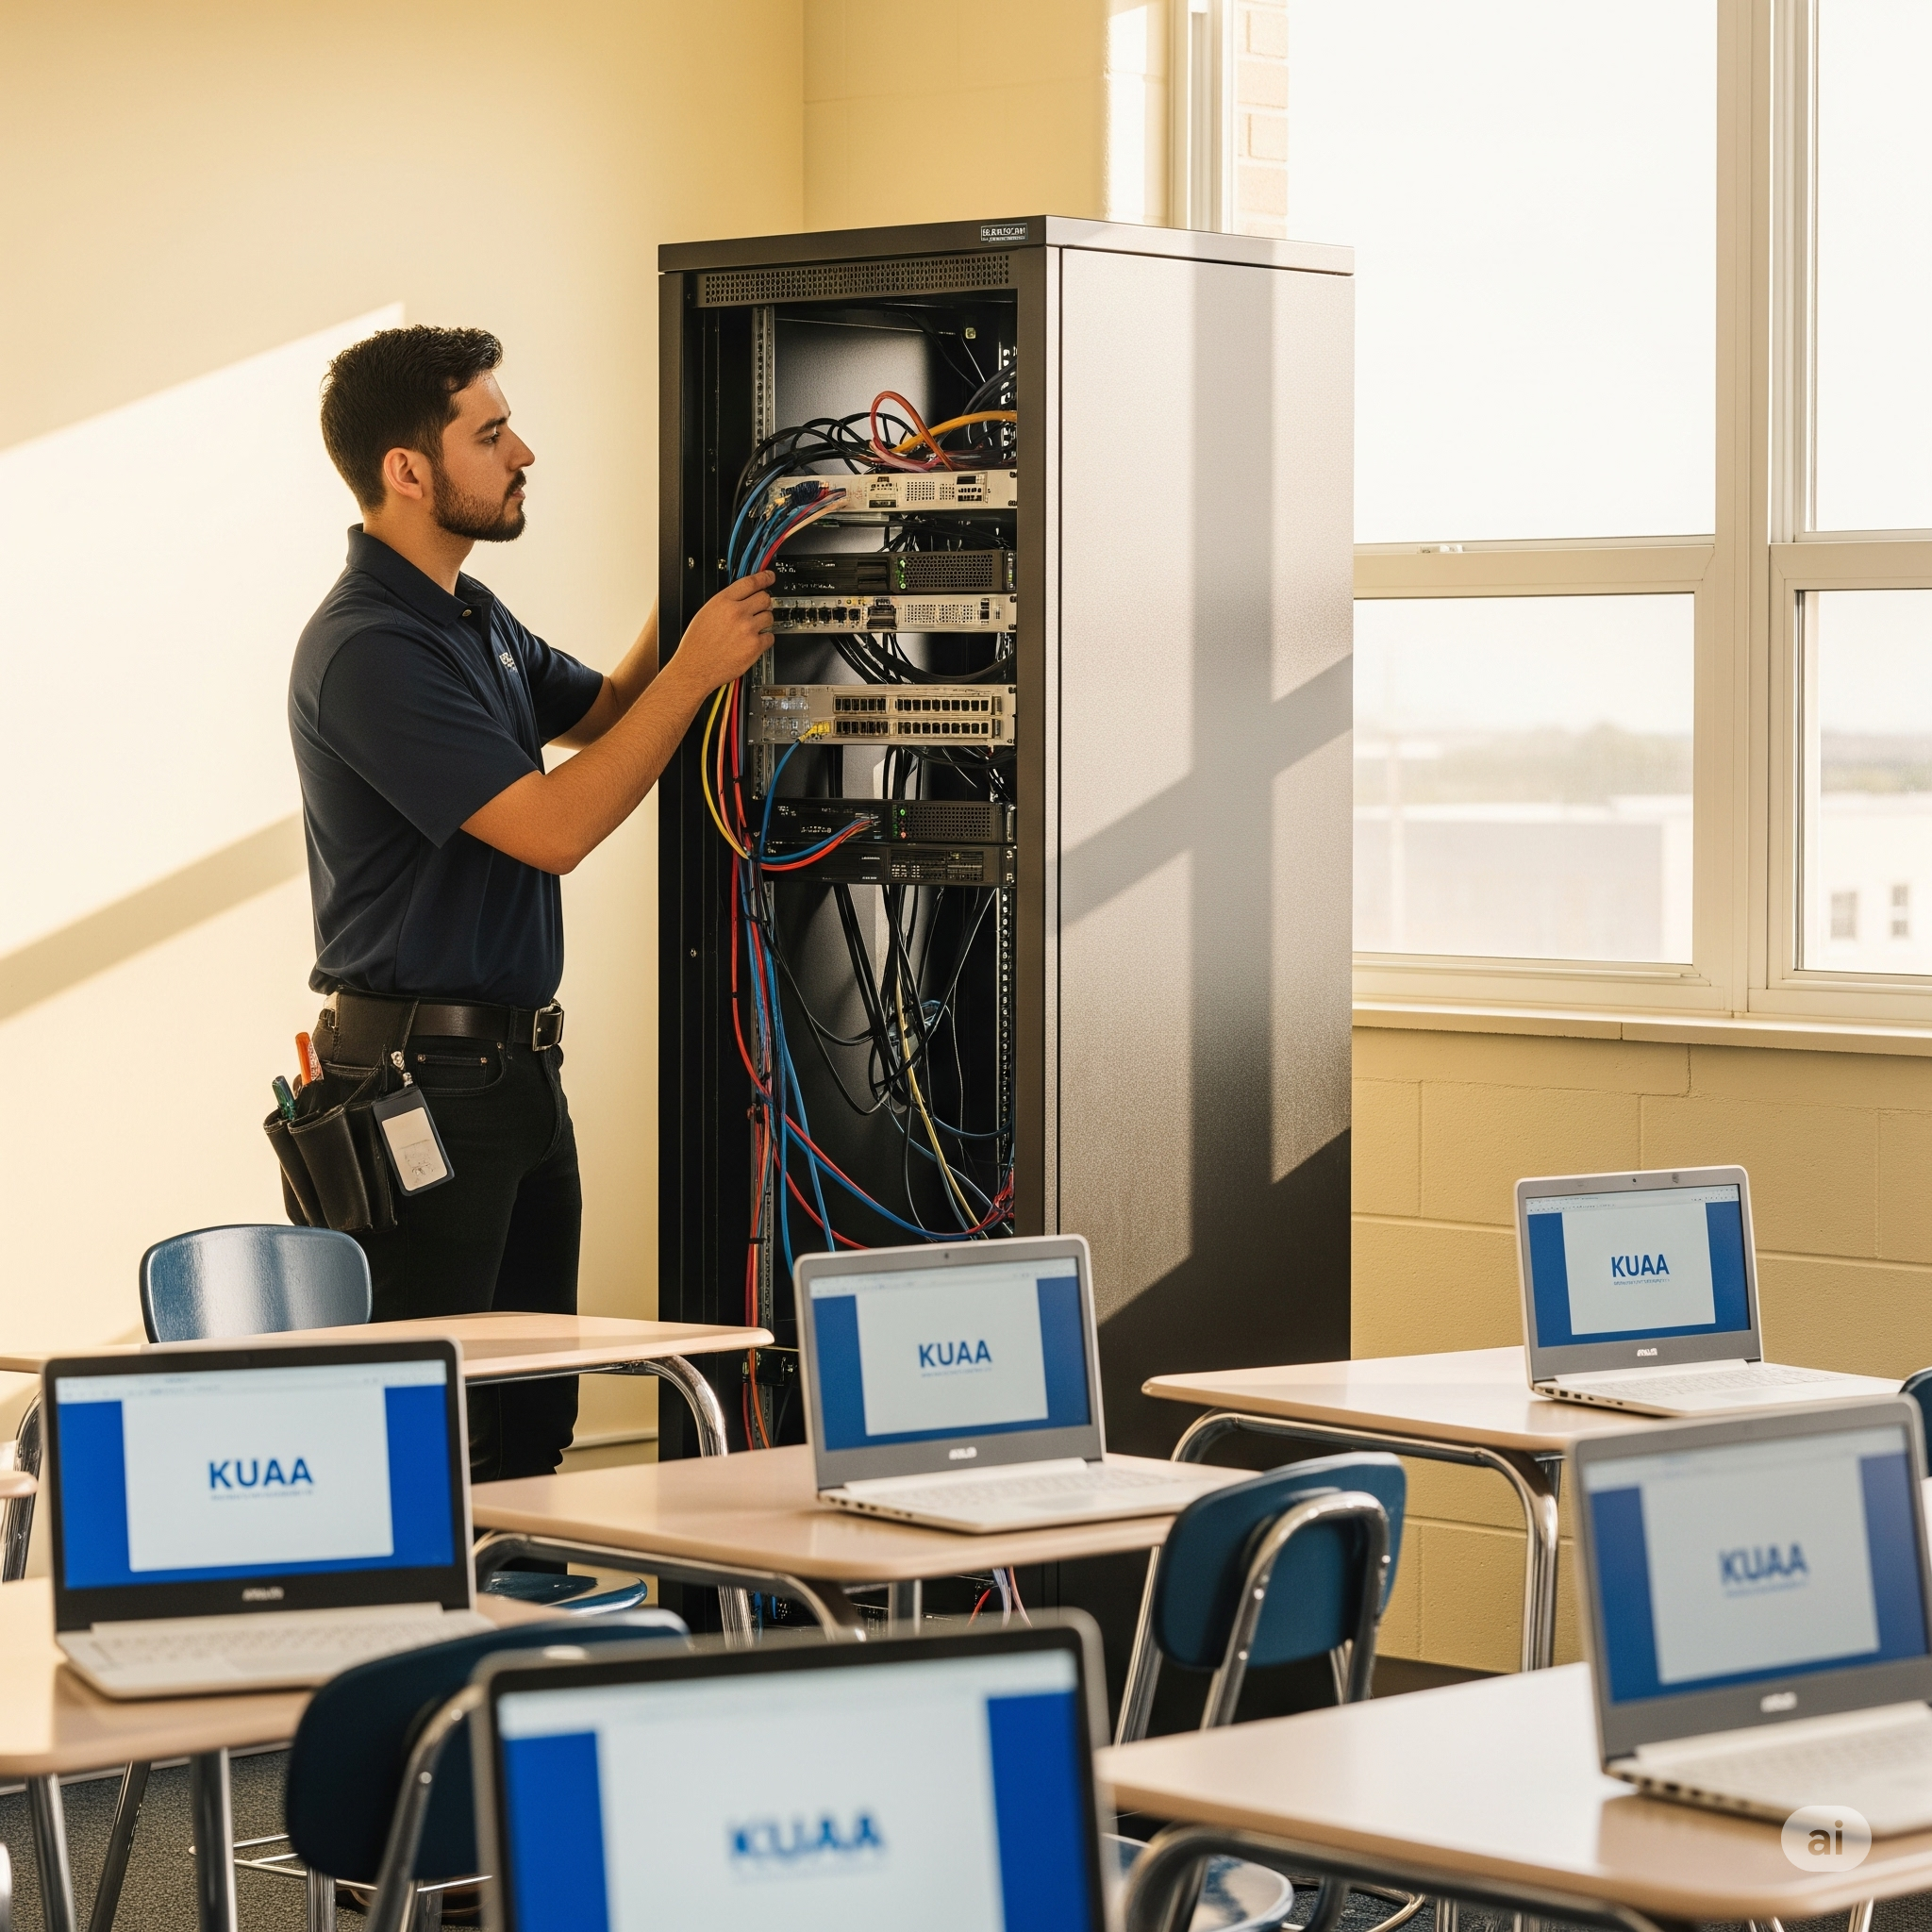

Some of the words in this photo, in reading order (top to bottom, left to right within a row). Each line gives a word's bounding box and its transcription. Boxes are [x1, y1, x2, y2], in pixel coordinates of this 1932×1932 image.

[1611, 1254, 1670, 1277] KUAA
[919, 1340, 991, 1368] KUAA
[209, 1457, 313, 1489] KUAA
[1720, 1542, 1808, 1584] KUAA
